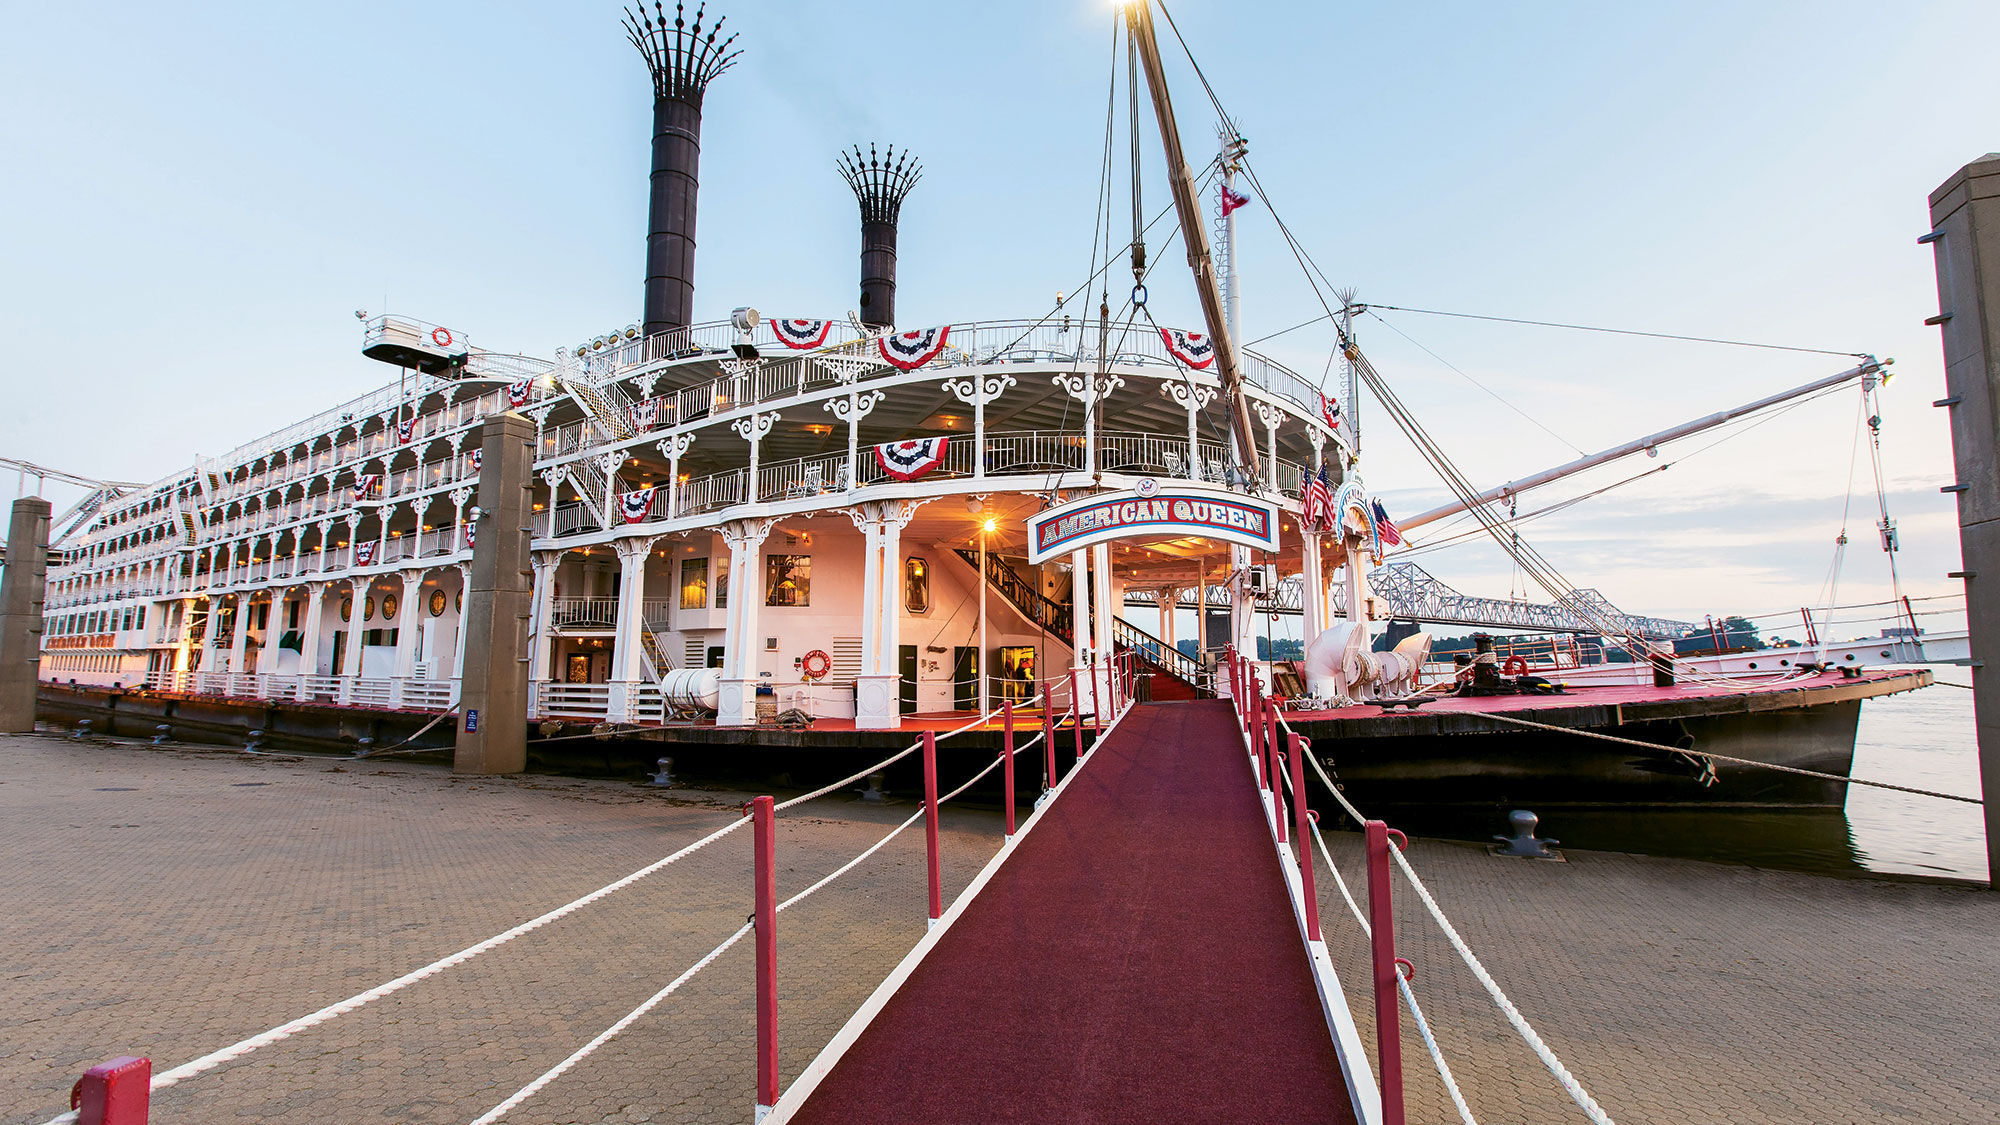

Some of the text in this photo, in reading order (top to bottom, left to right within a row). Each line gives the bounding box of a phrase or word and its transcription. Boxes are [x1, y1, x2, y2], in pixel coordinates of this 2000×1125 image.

[1041, 500, 1264, 548] AMERICAN QUEEN
[1321, 757, 1335, 766] 12
